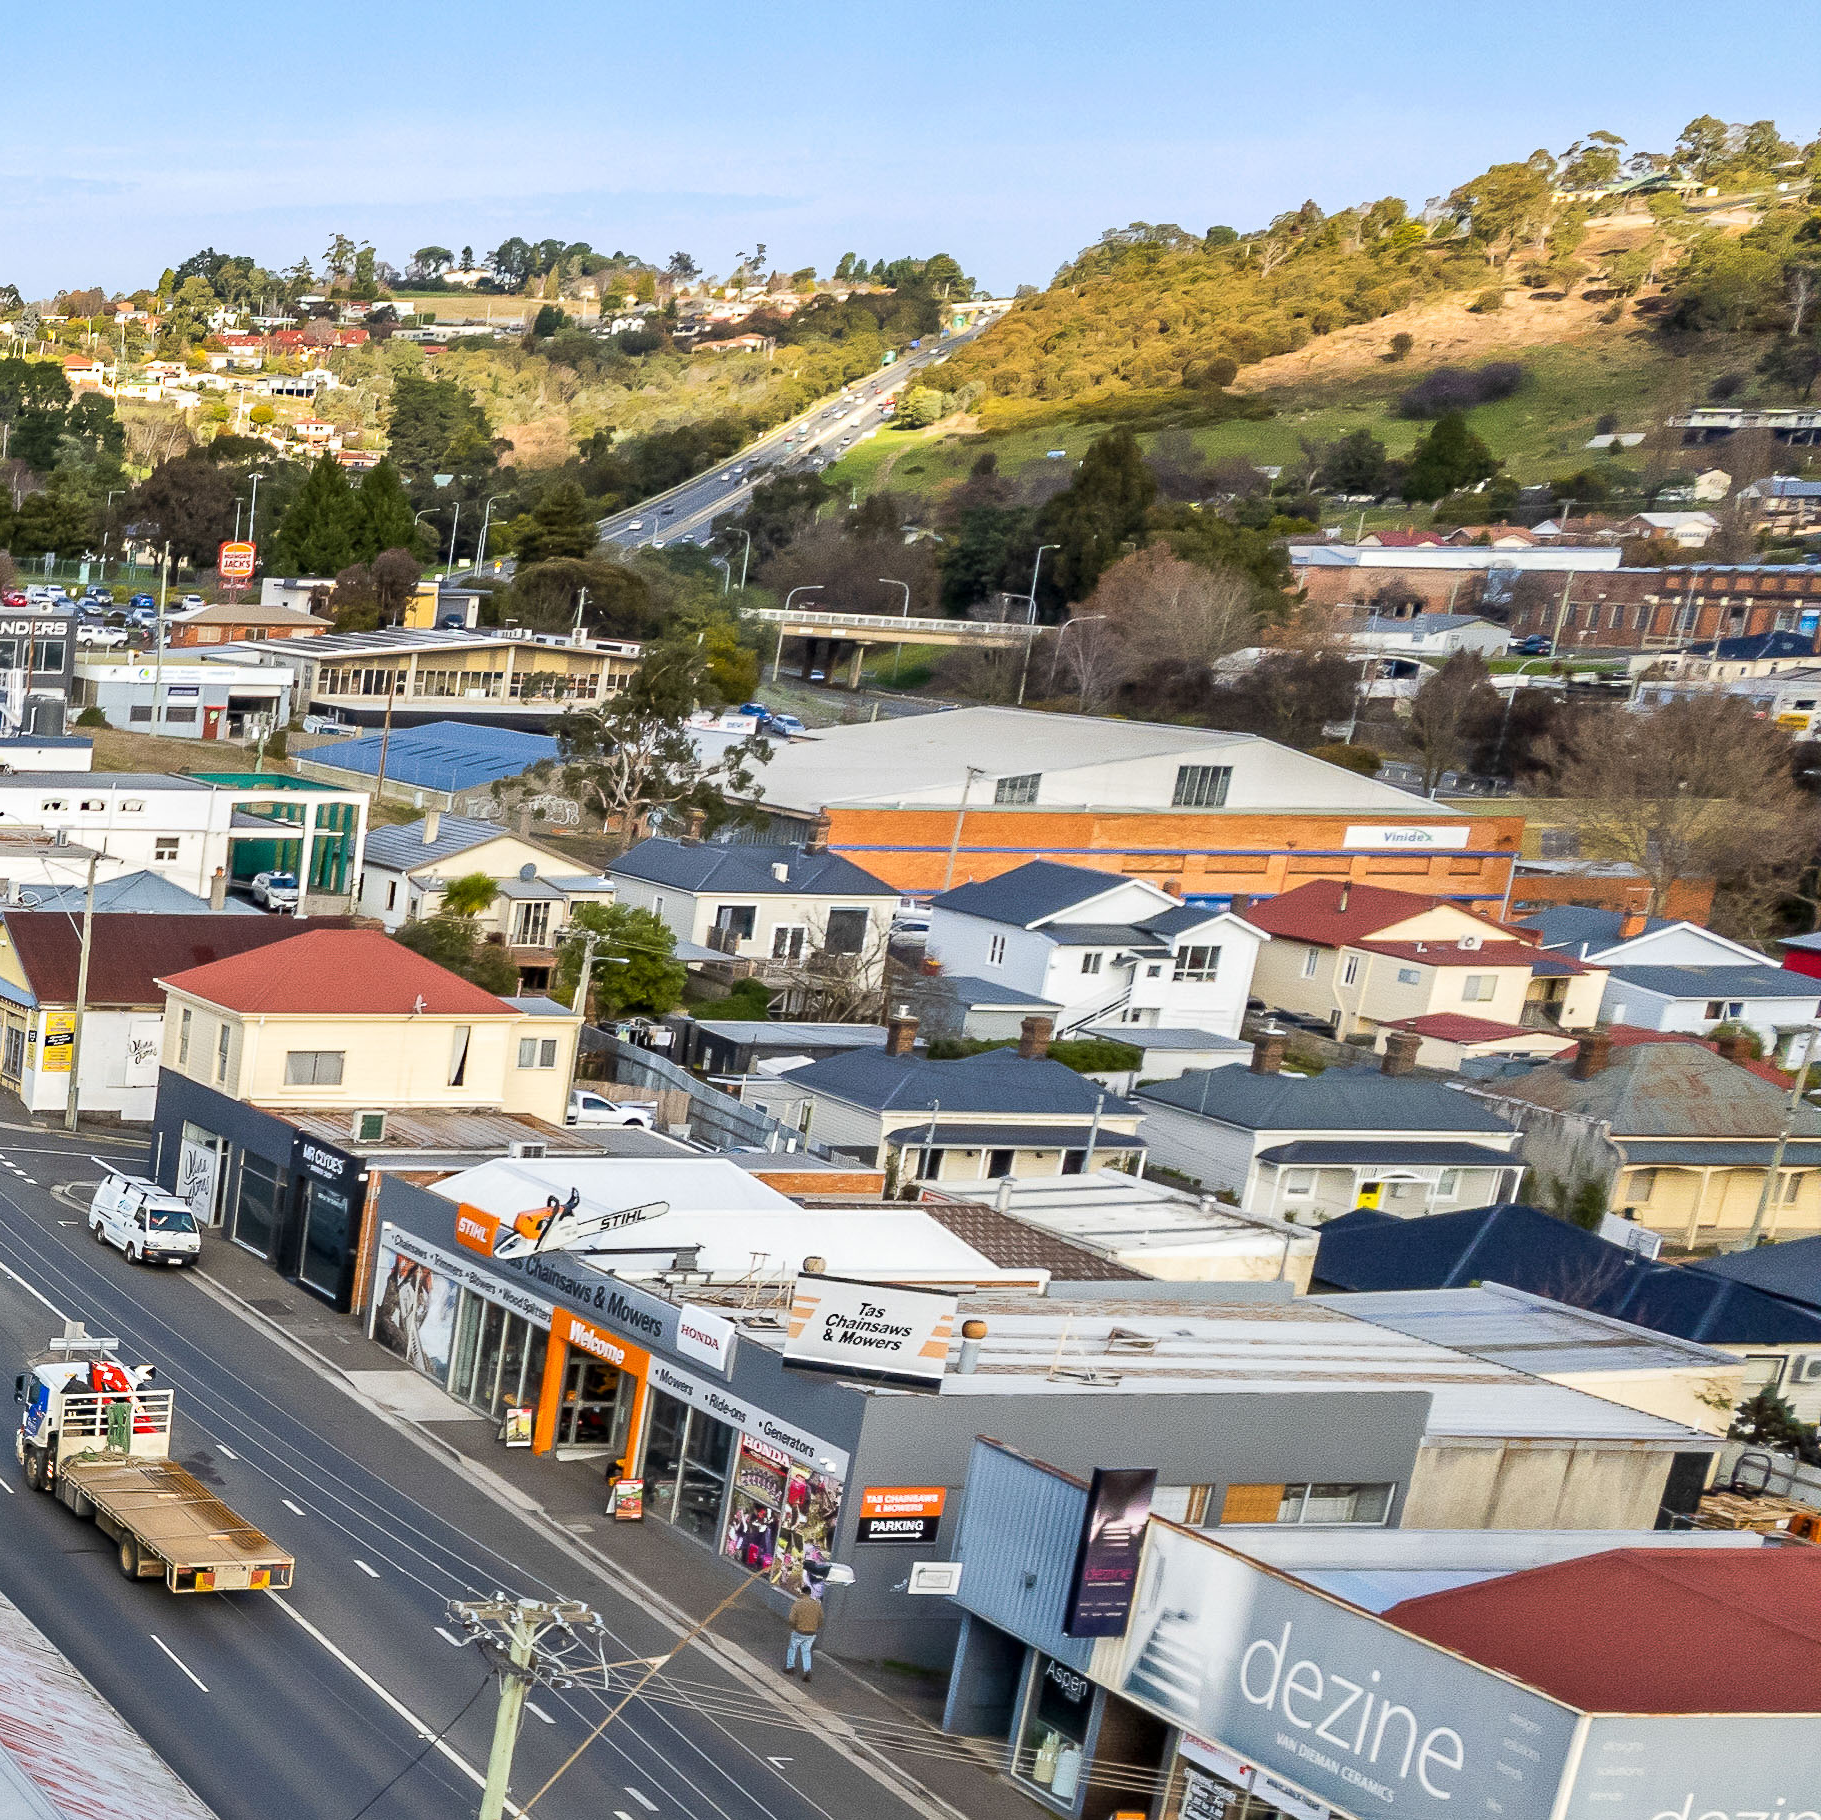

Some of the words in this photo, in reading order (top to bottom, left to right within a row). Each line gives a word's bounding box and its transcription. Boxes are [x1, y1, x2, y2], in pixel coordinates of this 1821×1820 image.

[1384, 832, 1433, 842] Vinidex
[458, 1216, 488, 1244] STIHL
[600, 1209, 647, 1231] STIHL
[526, 1255, 592, 1304] Chainsaws
[594, 1285, 605, 1307] &
[607, 1291, 663, 1338] Mowers
[859, 1302, 886, 1319] Tas
[681, 1323, 720, 1351] HONDA
[822, 1327, 834, 1342] &
[837, 1330, 903, 1351] Mowers
[825, 1313, 913, 1338] Chainsaws
[568, 1319, 625, 1366] Welcome
[659, 1368, 694, 1397] Mowers
[709, 1393, 747, 1424] Ride-ons
[763, 1420, 816, 1459] Generators
[742, 1433, 791, 1469] HONDA
[870, 1519, 924, 1532] PARKING
[1084, 1568, 1135, 1581] dezine
[1045, 1659, 1088, 1698] Aspen
[1239, 1620, 1465, 1800] dezine
[1276, 1731, 1297, 1754] VAN
[1340, 1764, 1396, 1804] CERAMICS
